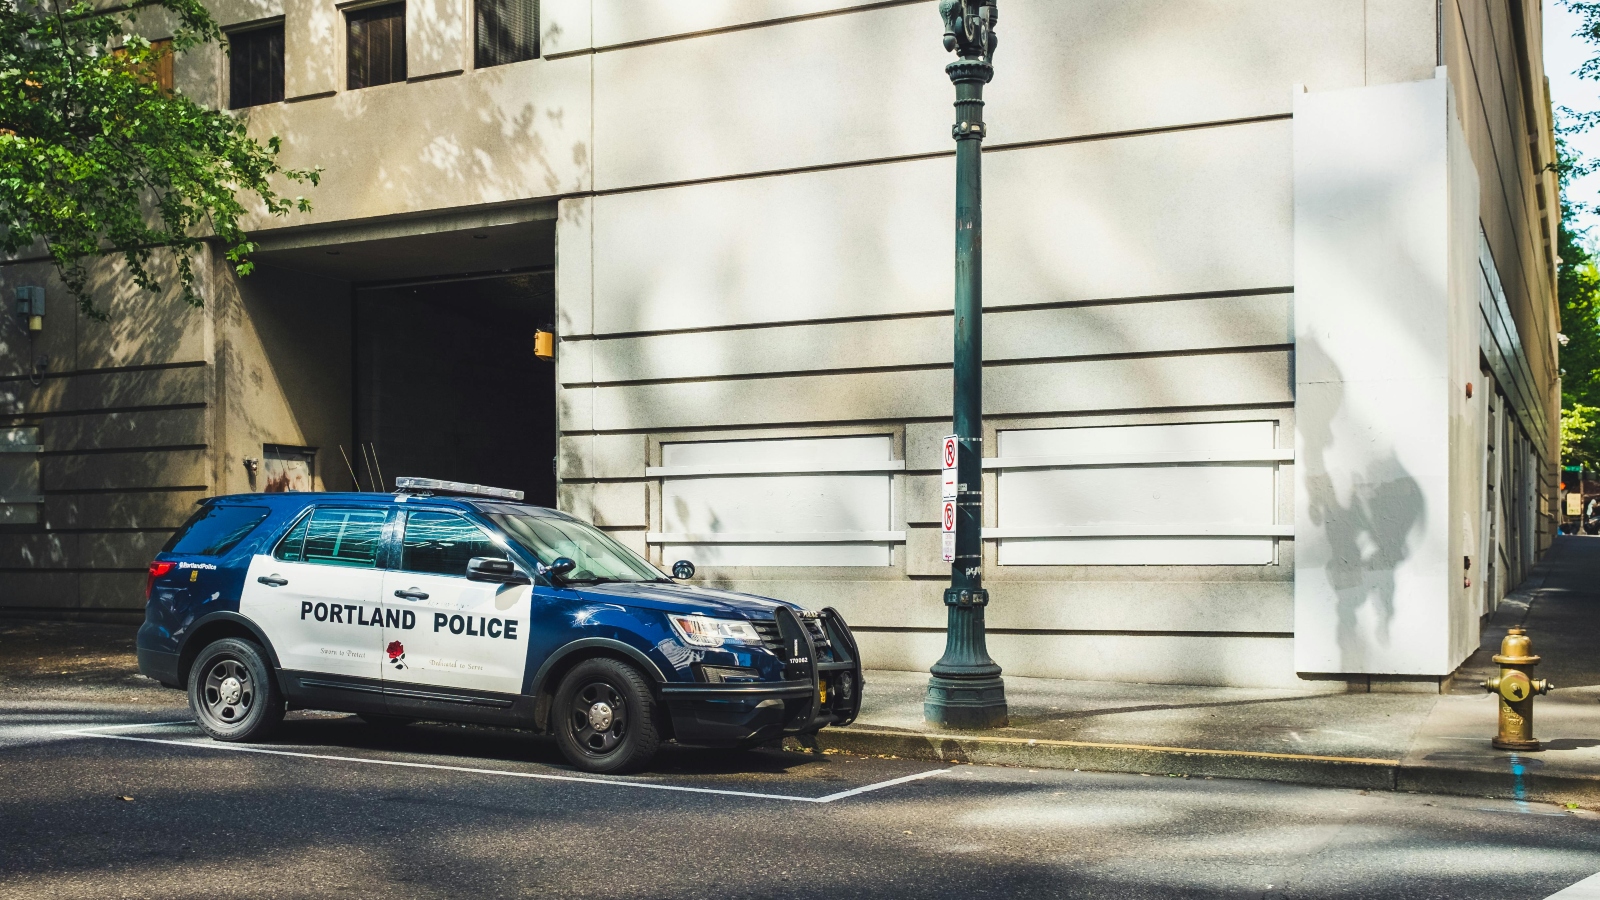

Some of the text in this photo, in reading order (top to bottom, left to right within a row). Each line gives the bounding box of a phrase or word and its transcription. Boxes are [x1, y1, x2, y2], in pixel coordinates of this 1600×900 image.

[301, 601, 518, 640] PORTLAND POLICE
[320, 647, 337, 656] Sworn
[346, 649, 366, 659] Protect
[429, 658, 458, 668] Dedicated
[467, 663, 483, 671] Serve
